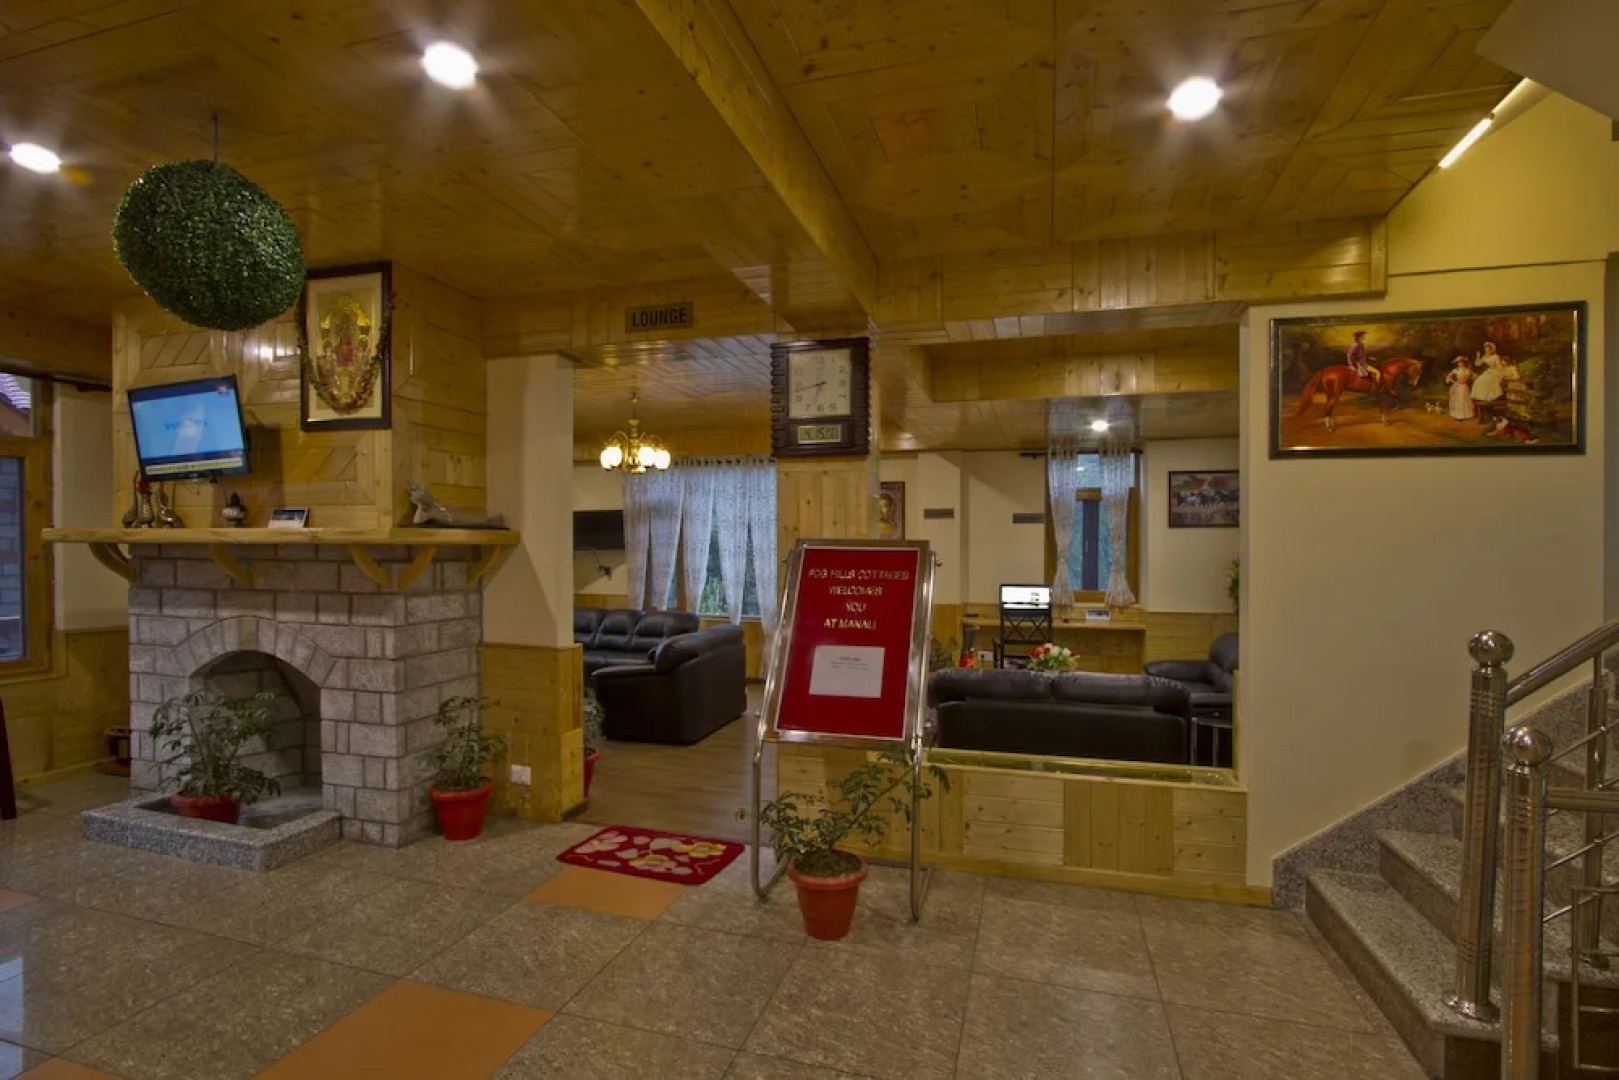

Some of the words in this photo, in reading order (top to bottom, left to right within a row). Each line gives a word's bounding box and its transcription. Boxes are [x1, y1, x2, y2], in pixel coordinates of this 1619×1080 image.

[632, 308, 686, 327] LOUNGE
[858, 569, 910, 580] COTTAGES
[828, 586, 883, 596] WELCOMES
[845, 602, 867, 612] YOU
[823, 618, 838, 629] AT
[839, 619, 877, 629] MANALI
